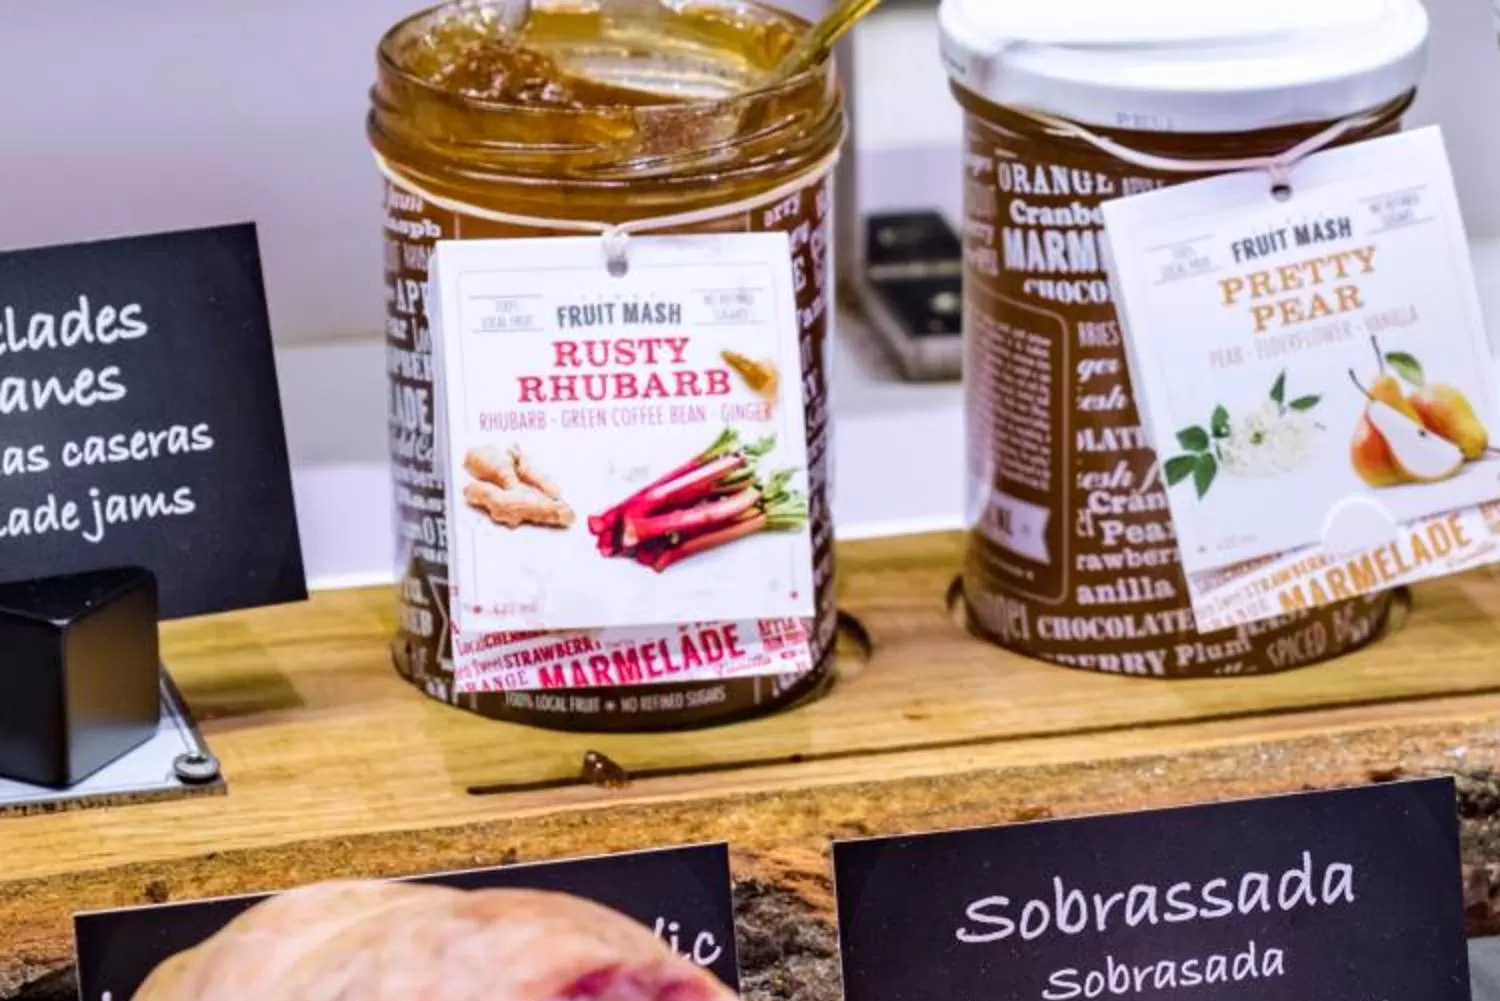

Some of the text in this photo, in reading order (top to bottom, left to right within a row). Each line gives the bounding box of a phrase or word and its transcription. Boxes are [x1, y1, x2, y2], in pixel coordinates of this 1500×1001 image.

[1003, 228, 1108, 272] MARM
[1231, 229, 1289, 264] FRUIT
[1292, 216, 1353, 248] MASH
[1218, 245, 1378, 306] PRETTY
[556, 303, 615, 329] FRUIT
[621, 302, 682, 326] MASH
[1249, 284, 1366, 333] PEAR
[552, 337, 691, 369] RUSTY
[516, 369, 732, 403] RHUBARB
[478, 410, 547, 432] RHUBARB
[561, 407, 608, 430] GREEN
[611, 405, 664, 429] COFFEE
[669, 404, 707, 424] BEAN
[0, 423, 215, 476] as caseras
[0, 487, 197, 543] ade jams
[1278, 511, 1472, 613] MARMELADE
[537, 622, 746, 689] MARMELADE
[954, 850, 1356, 944] Sobrassada
